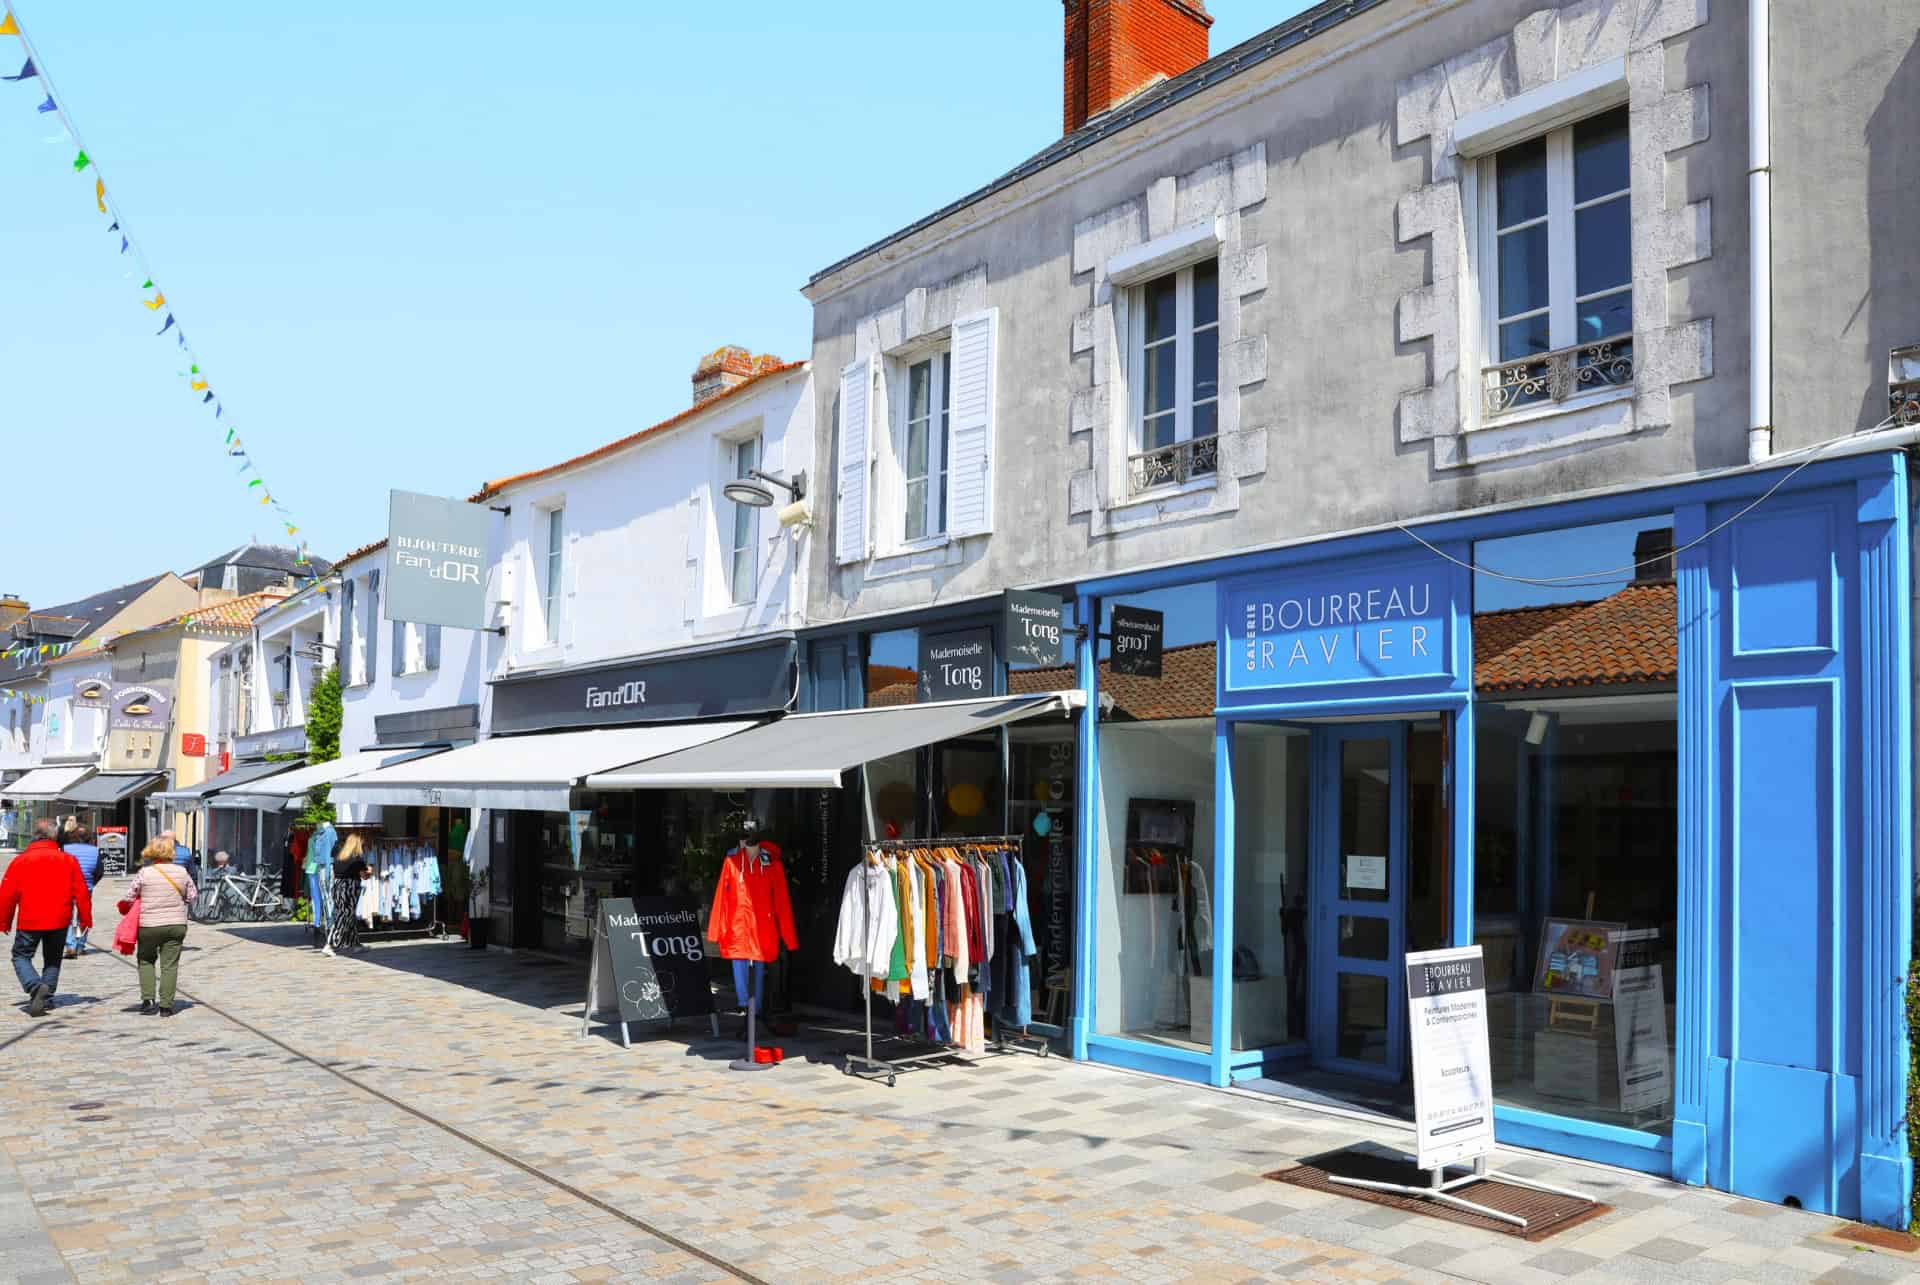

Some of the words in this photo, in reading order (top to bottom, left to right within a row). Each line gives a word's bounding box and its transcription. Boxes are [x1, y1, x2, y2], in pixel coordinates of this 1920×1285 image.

[397, 535, 481, 558] BIJOUTERIE
[396, 551, 431, 569] Fan
[1011, 603, 1059, 618] Mademoiselle
[1262, 583, 1430, 632] BOURREAU
[1021, 617, 1060, 645] Tong
[1246, 603, 1257, 671] GALERIE
[930, 643, 983, 661] Mademoiselle
[1262, 625, 1428, 669] RAVIER
[940, 663, 982, 690] Tong
[608, 910, 696, 928] Mademoiselle
[631, 931, 703, 961] Tong
[1429, 962, 1471, 978] BOURREAU
[1430, 976, 1471, 992] RAVIER
